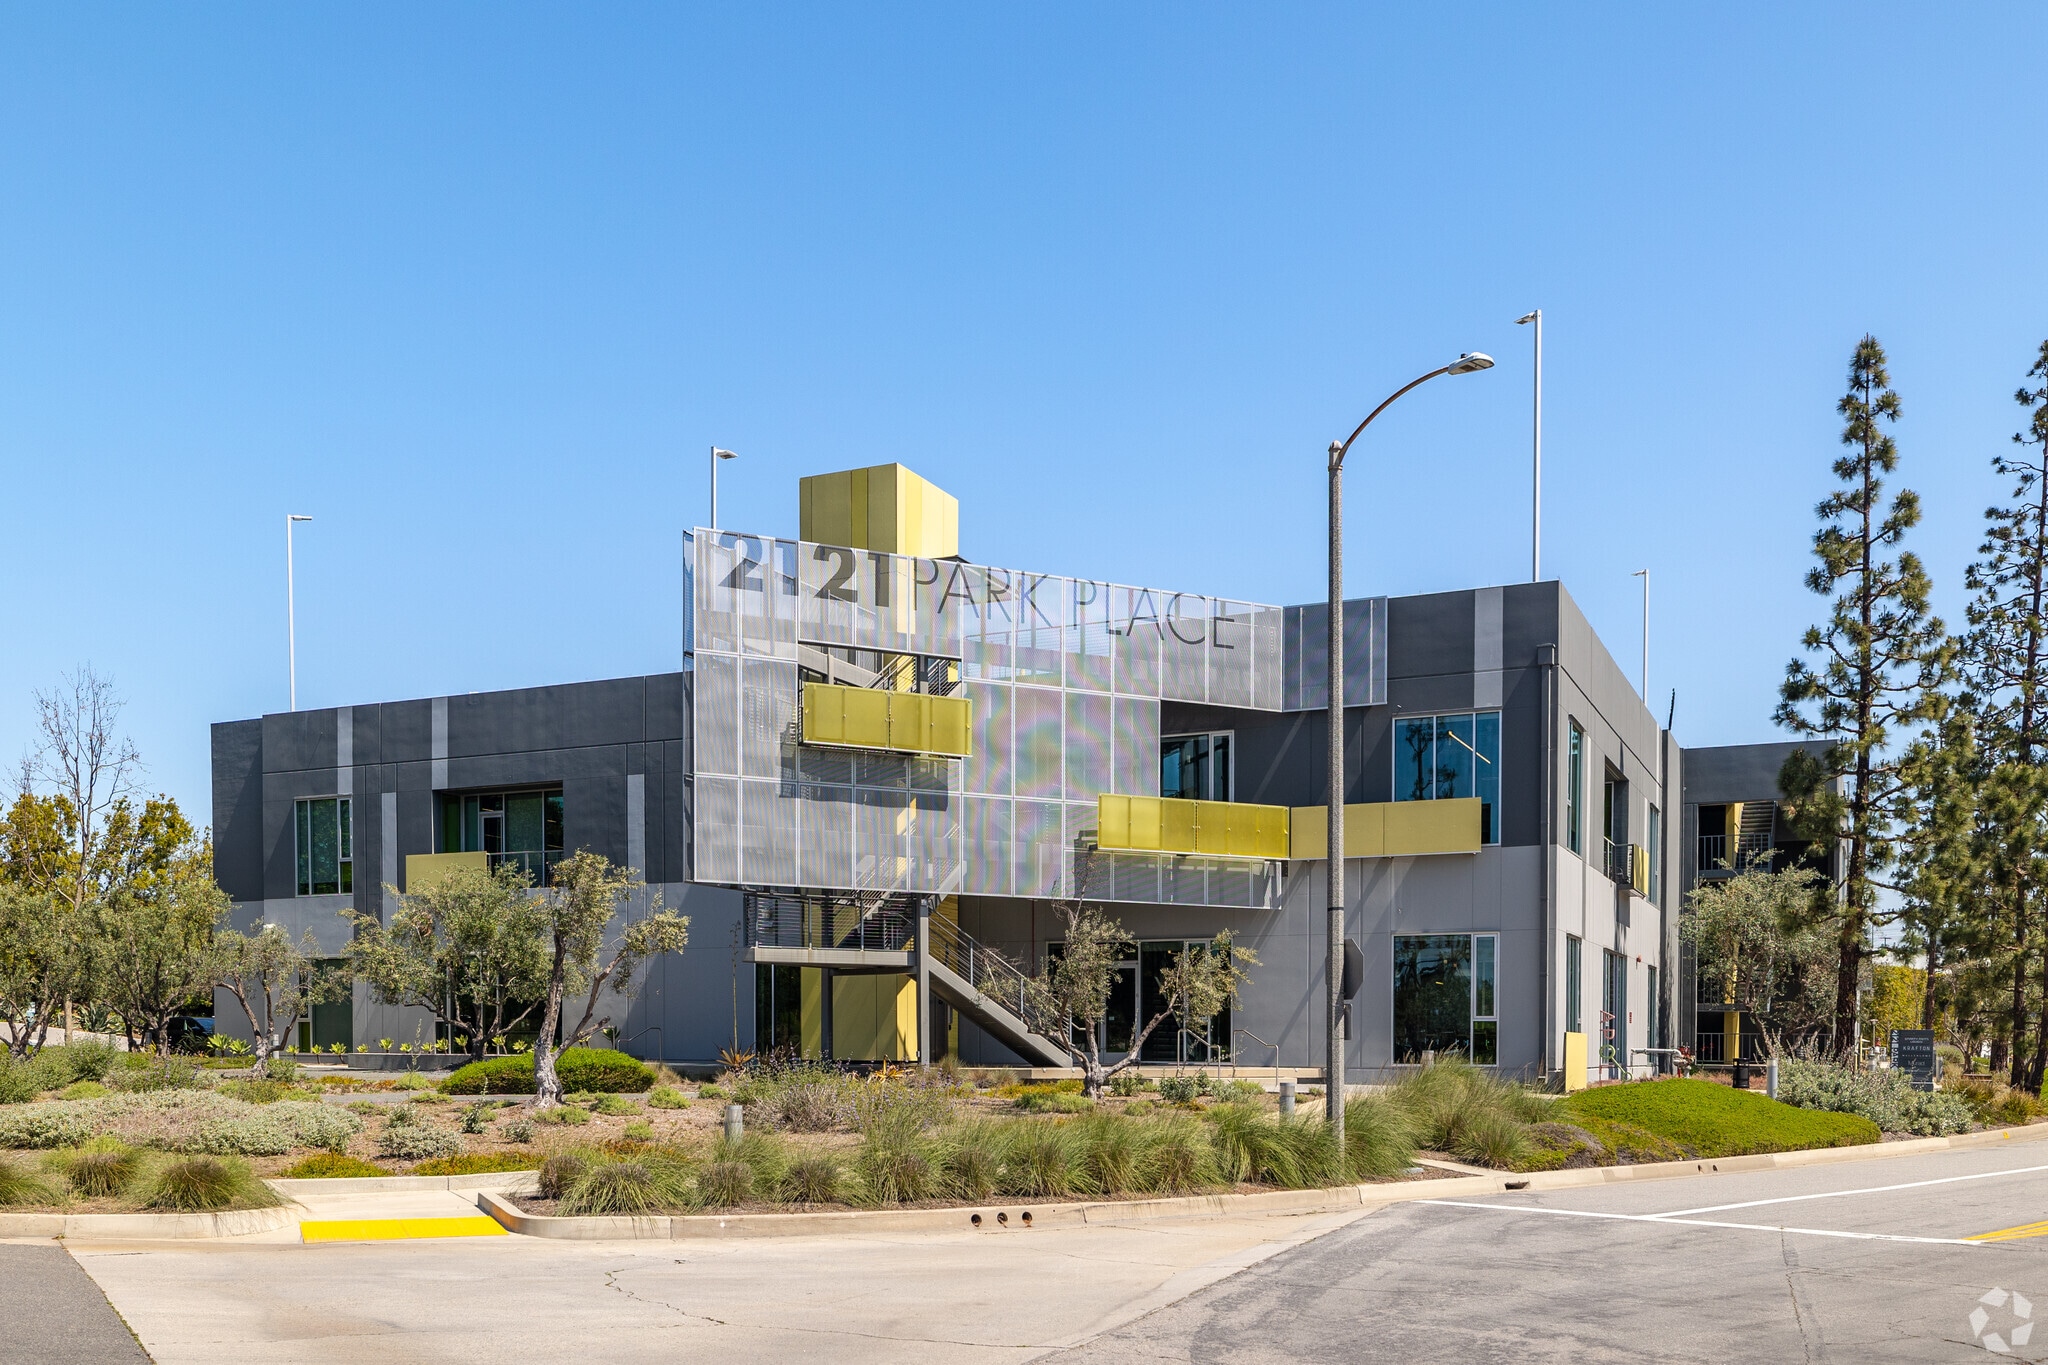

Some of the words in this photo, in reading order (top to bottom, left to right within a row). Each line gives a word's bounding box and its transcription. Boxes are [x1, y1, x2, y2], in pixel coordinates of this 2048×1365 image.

[718, 530, 889, 607] 2121
[914, 557, 1053, 628] PARK
[1073, 578, 1234, 650] PLACE
